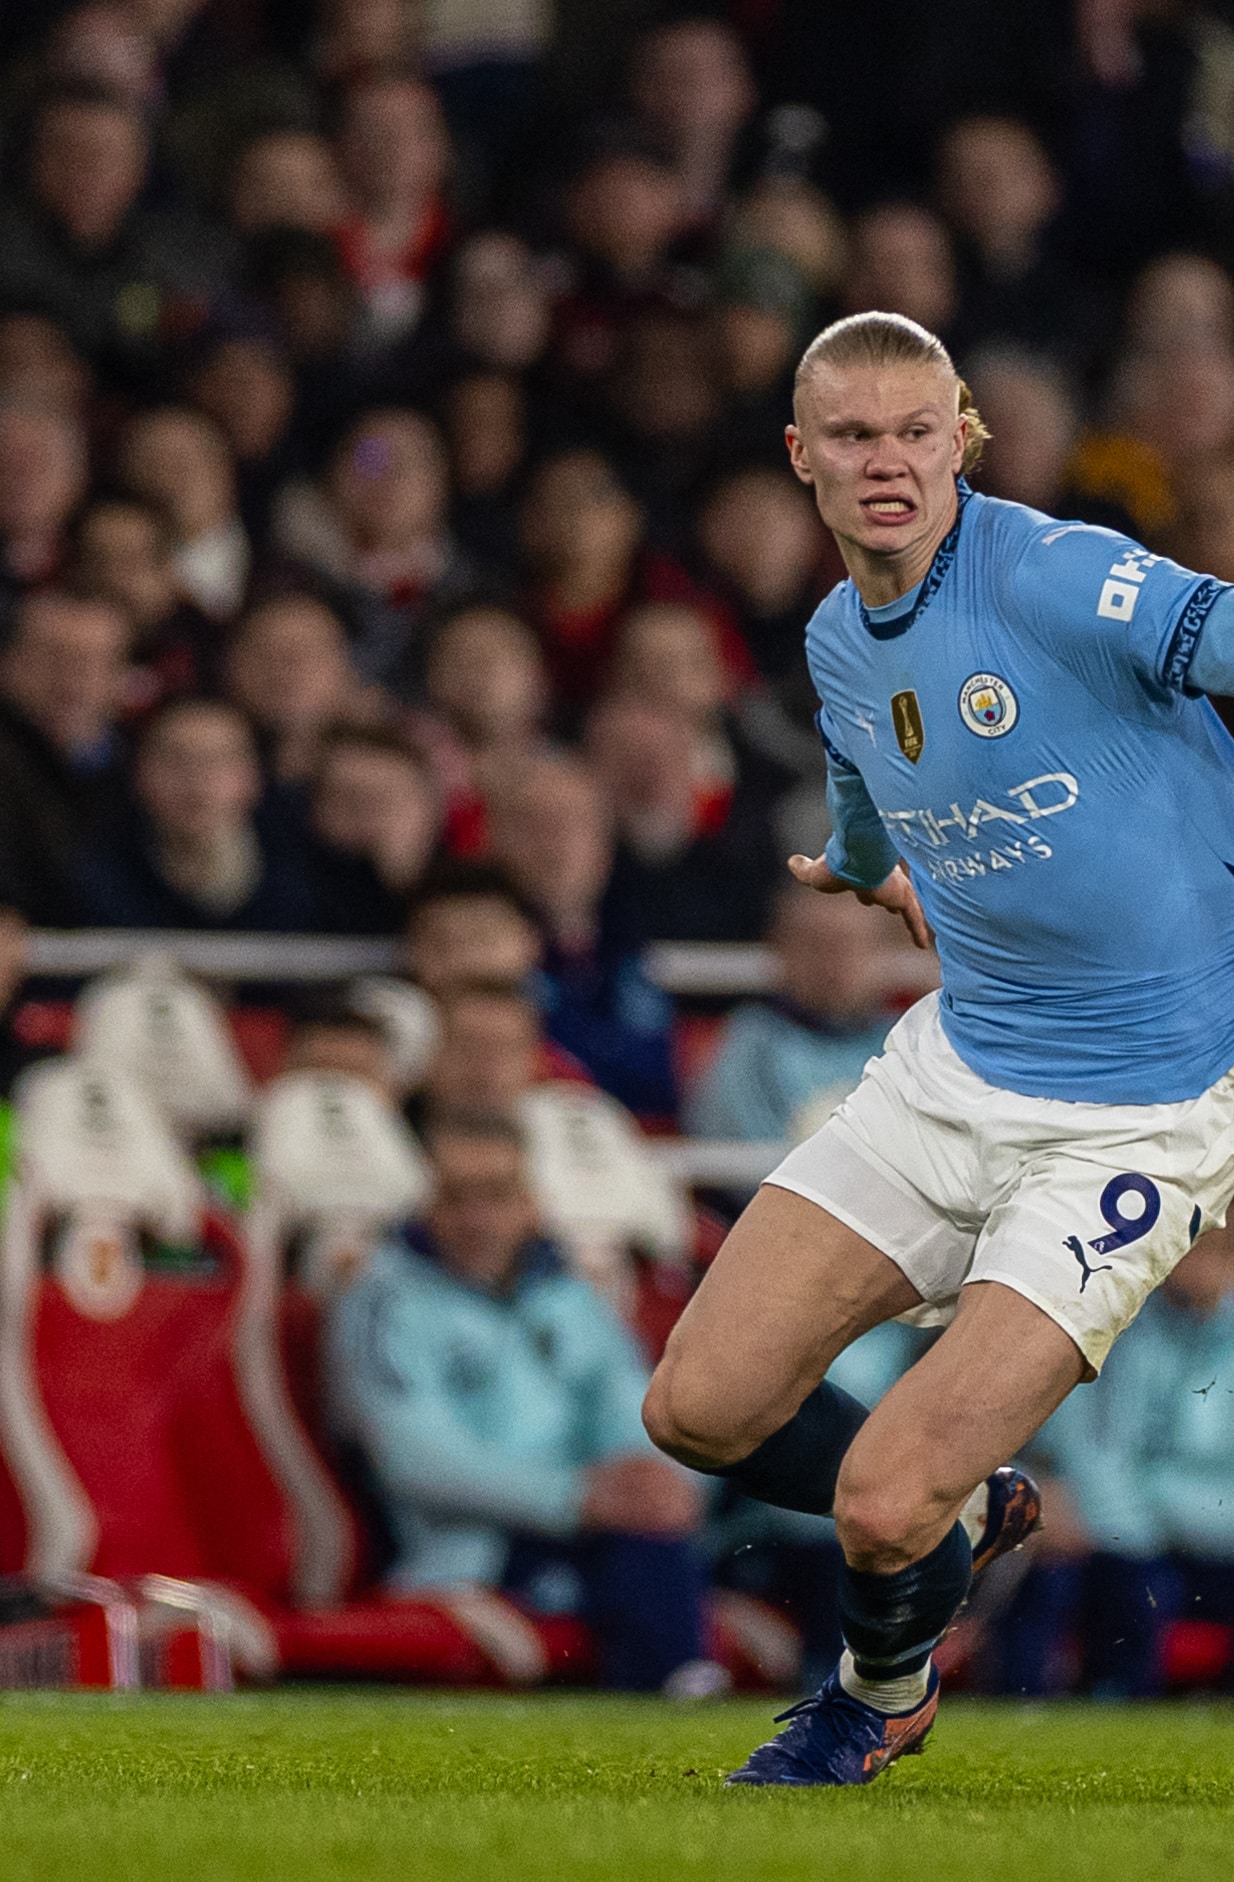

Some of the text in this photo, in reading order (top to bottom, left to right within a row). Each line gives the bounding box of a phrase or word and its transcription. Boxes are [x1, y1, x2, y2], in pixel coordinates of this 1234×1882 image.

[962, 676, 1004, 704] MANCHESTER
[987, 724, 1006, 735] CITY
[1087, 1172, 1161, 1255] 9
